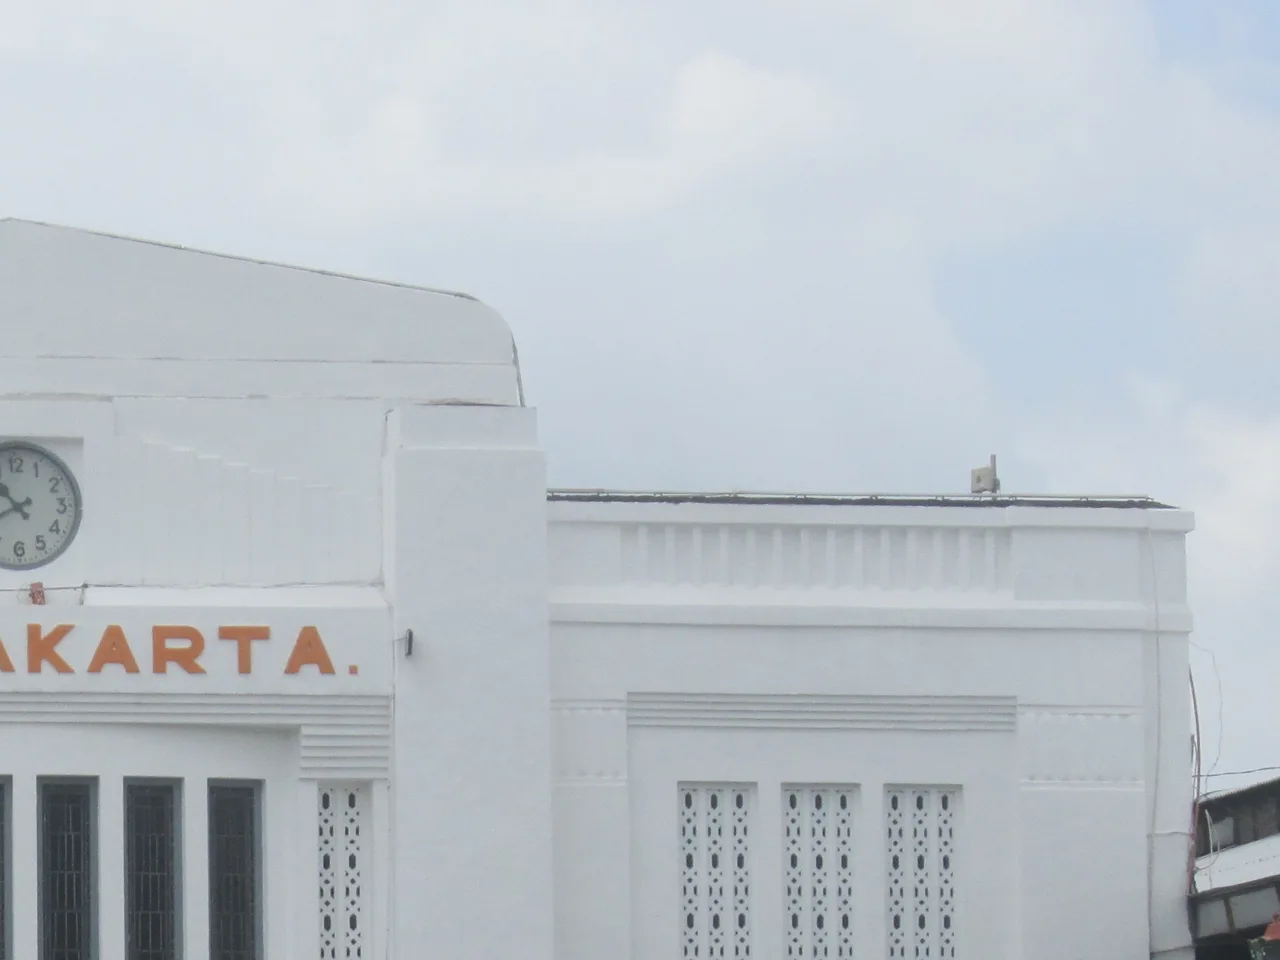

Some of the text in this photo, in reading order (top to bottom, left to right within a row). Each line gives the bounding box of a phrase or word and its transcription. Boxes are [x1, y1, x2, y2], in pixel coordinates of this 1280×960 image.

[8, 456, 24, 473] 12
[33, 462, 39, 478] 1
[48, 477, 60, 493] 2
[56, 498, 67, 514] 3
[48, 519, 60, 534] 4
[13, 541, 25, 557] 6
[35, 535, 46, 550] 5
